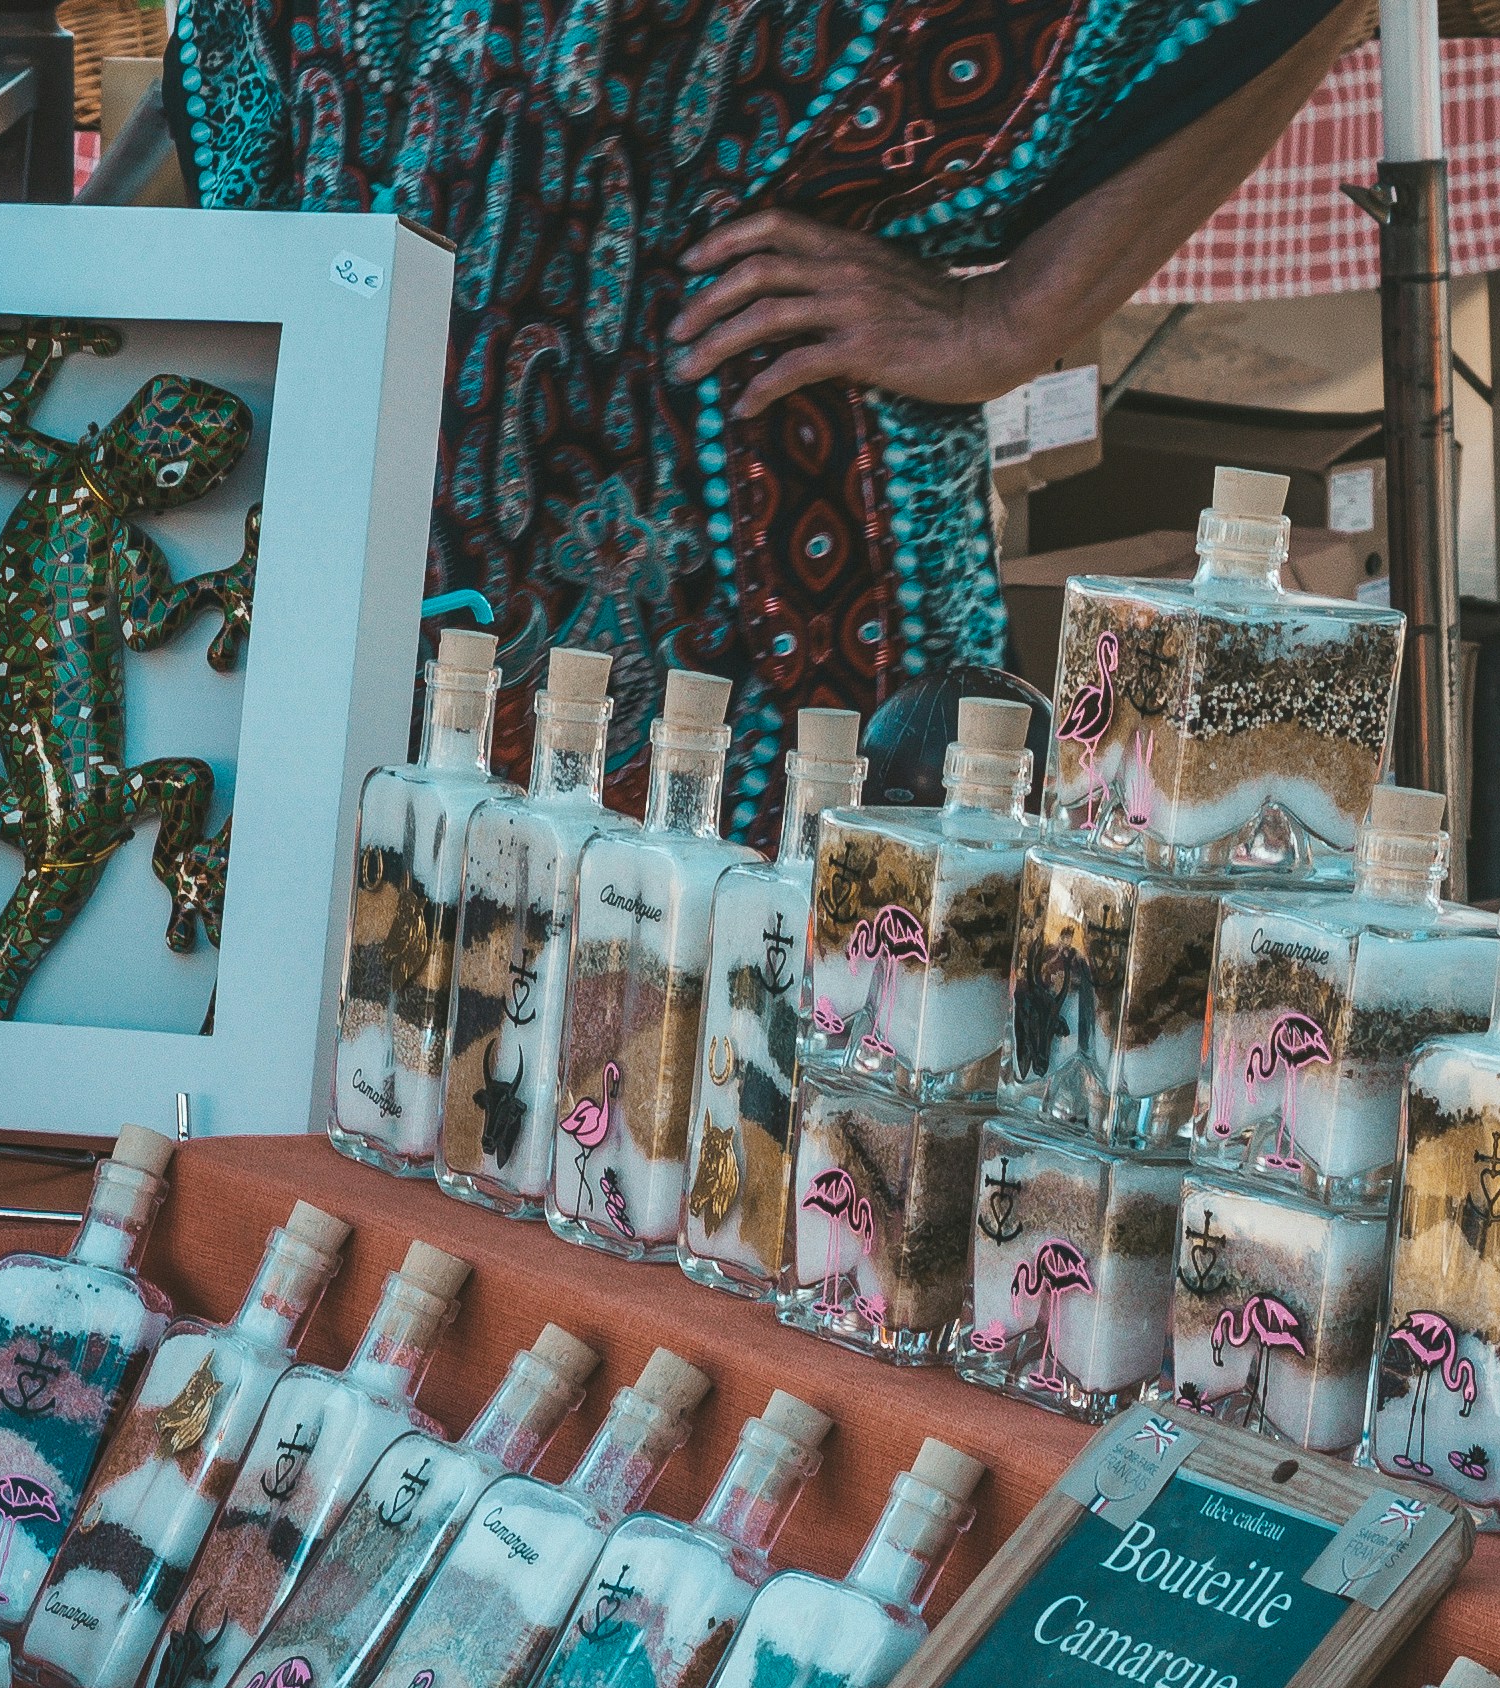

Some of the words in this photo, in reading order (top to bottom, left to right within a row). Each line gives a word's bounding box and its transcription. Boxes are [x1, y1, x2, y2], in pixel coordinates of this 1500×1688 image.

[334, 259, 360, 285] 20
[599, 883, 662, 924] Camargue
[1250, 926, 1331, 967] Camargue
[352, 1069, 404, 1120] Camargue
[481, 1506, 540, 1566] Camargue
[1235, 1507, 1285, 1541] cadeau
[1101, 1521, 1292, 1629] Bouteille
[44, 1590, 100, 1632] Camargue
